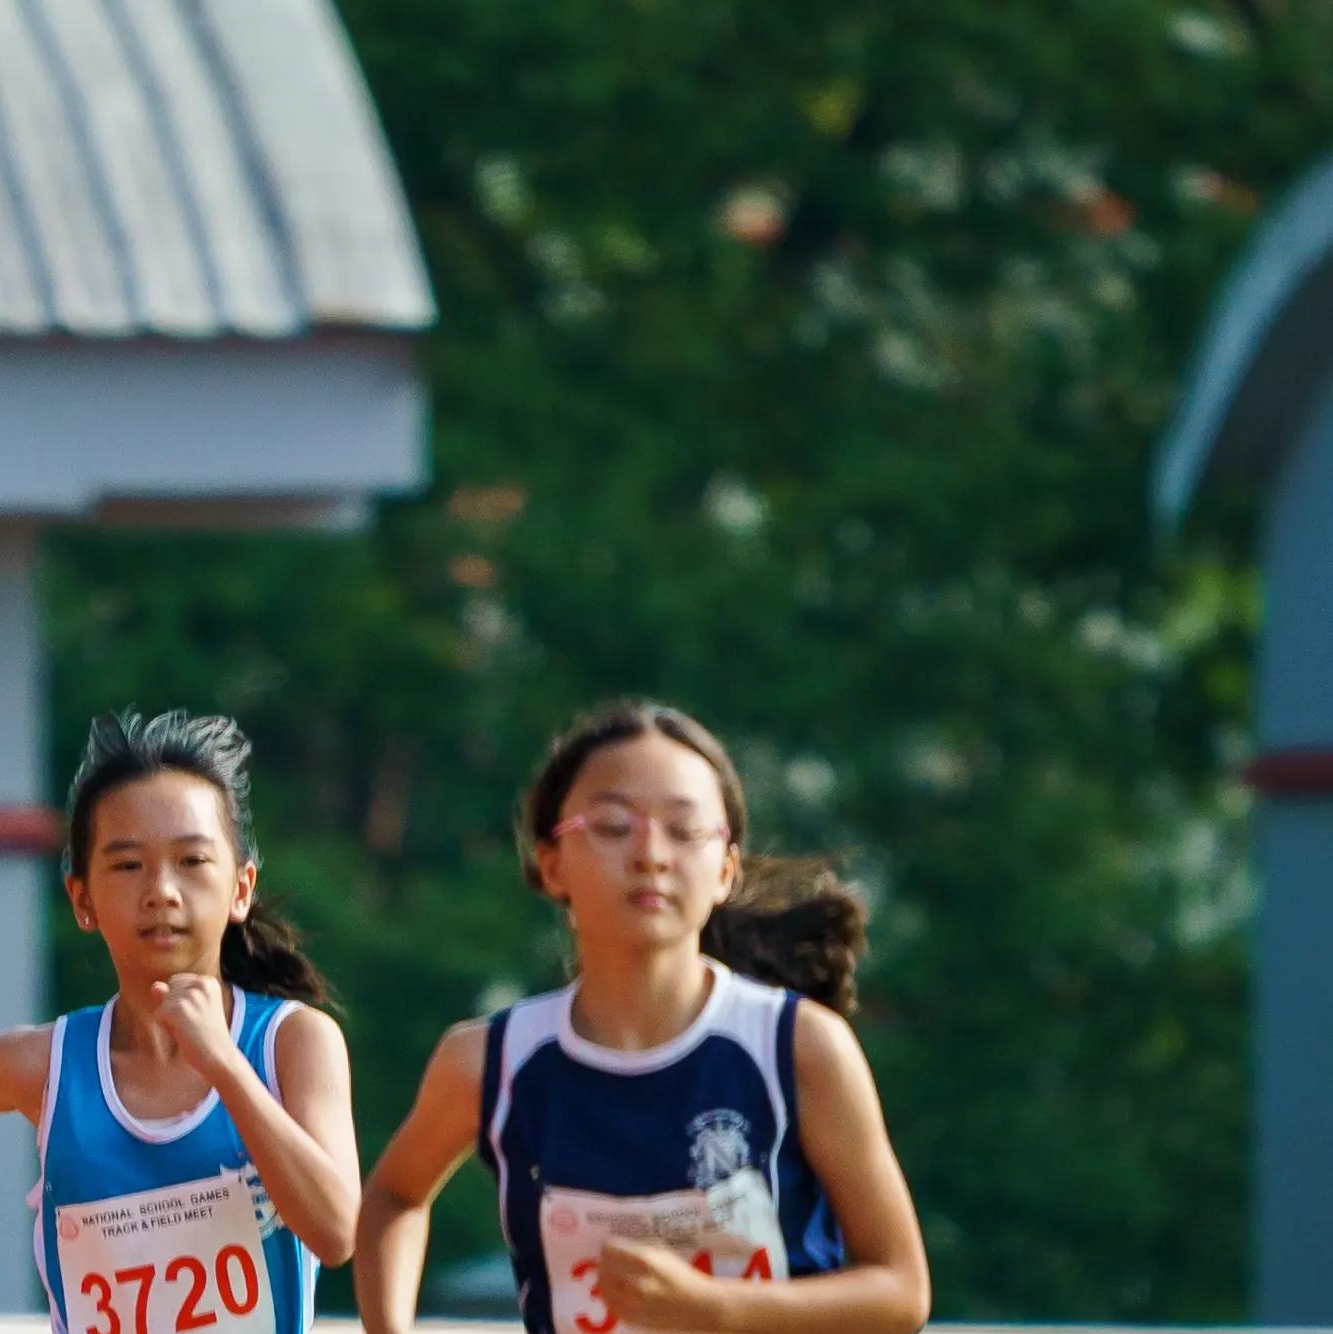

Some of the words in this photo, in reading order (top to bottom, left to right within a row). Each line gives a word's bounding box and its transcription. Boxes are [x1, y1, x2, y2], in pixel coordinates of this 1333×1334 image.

[80, 1208, 133, 1227] NATIONAL
[139, 1198, 185, 1217] SCHOOL
[190, 1187, 231, 1204] GAMES
[101, 1222, 139, 1239] TRACK
[141, 1220, 149, 1232] &
[150, 1211, 182, 1228] FIELD
[184, 1205, 214, 1221] MEET
